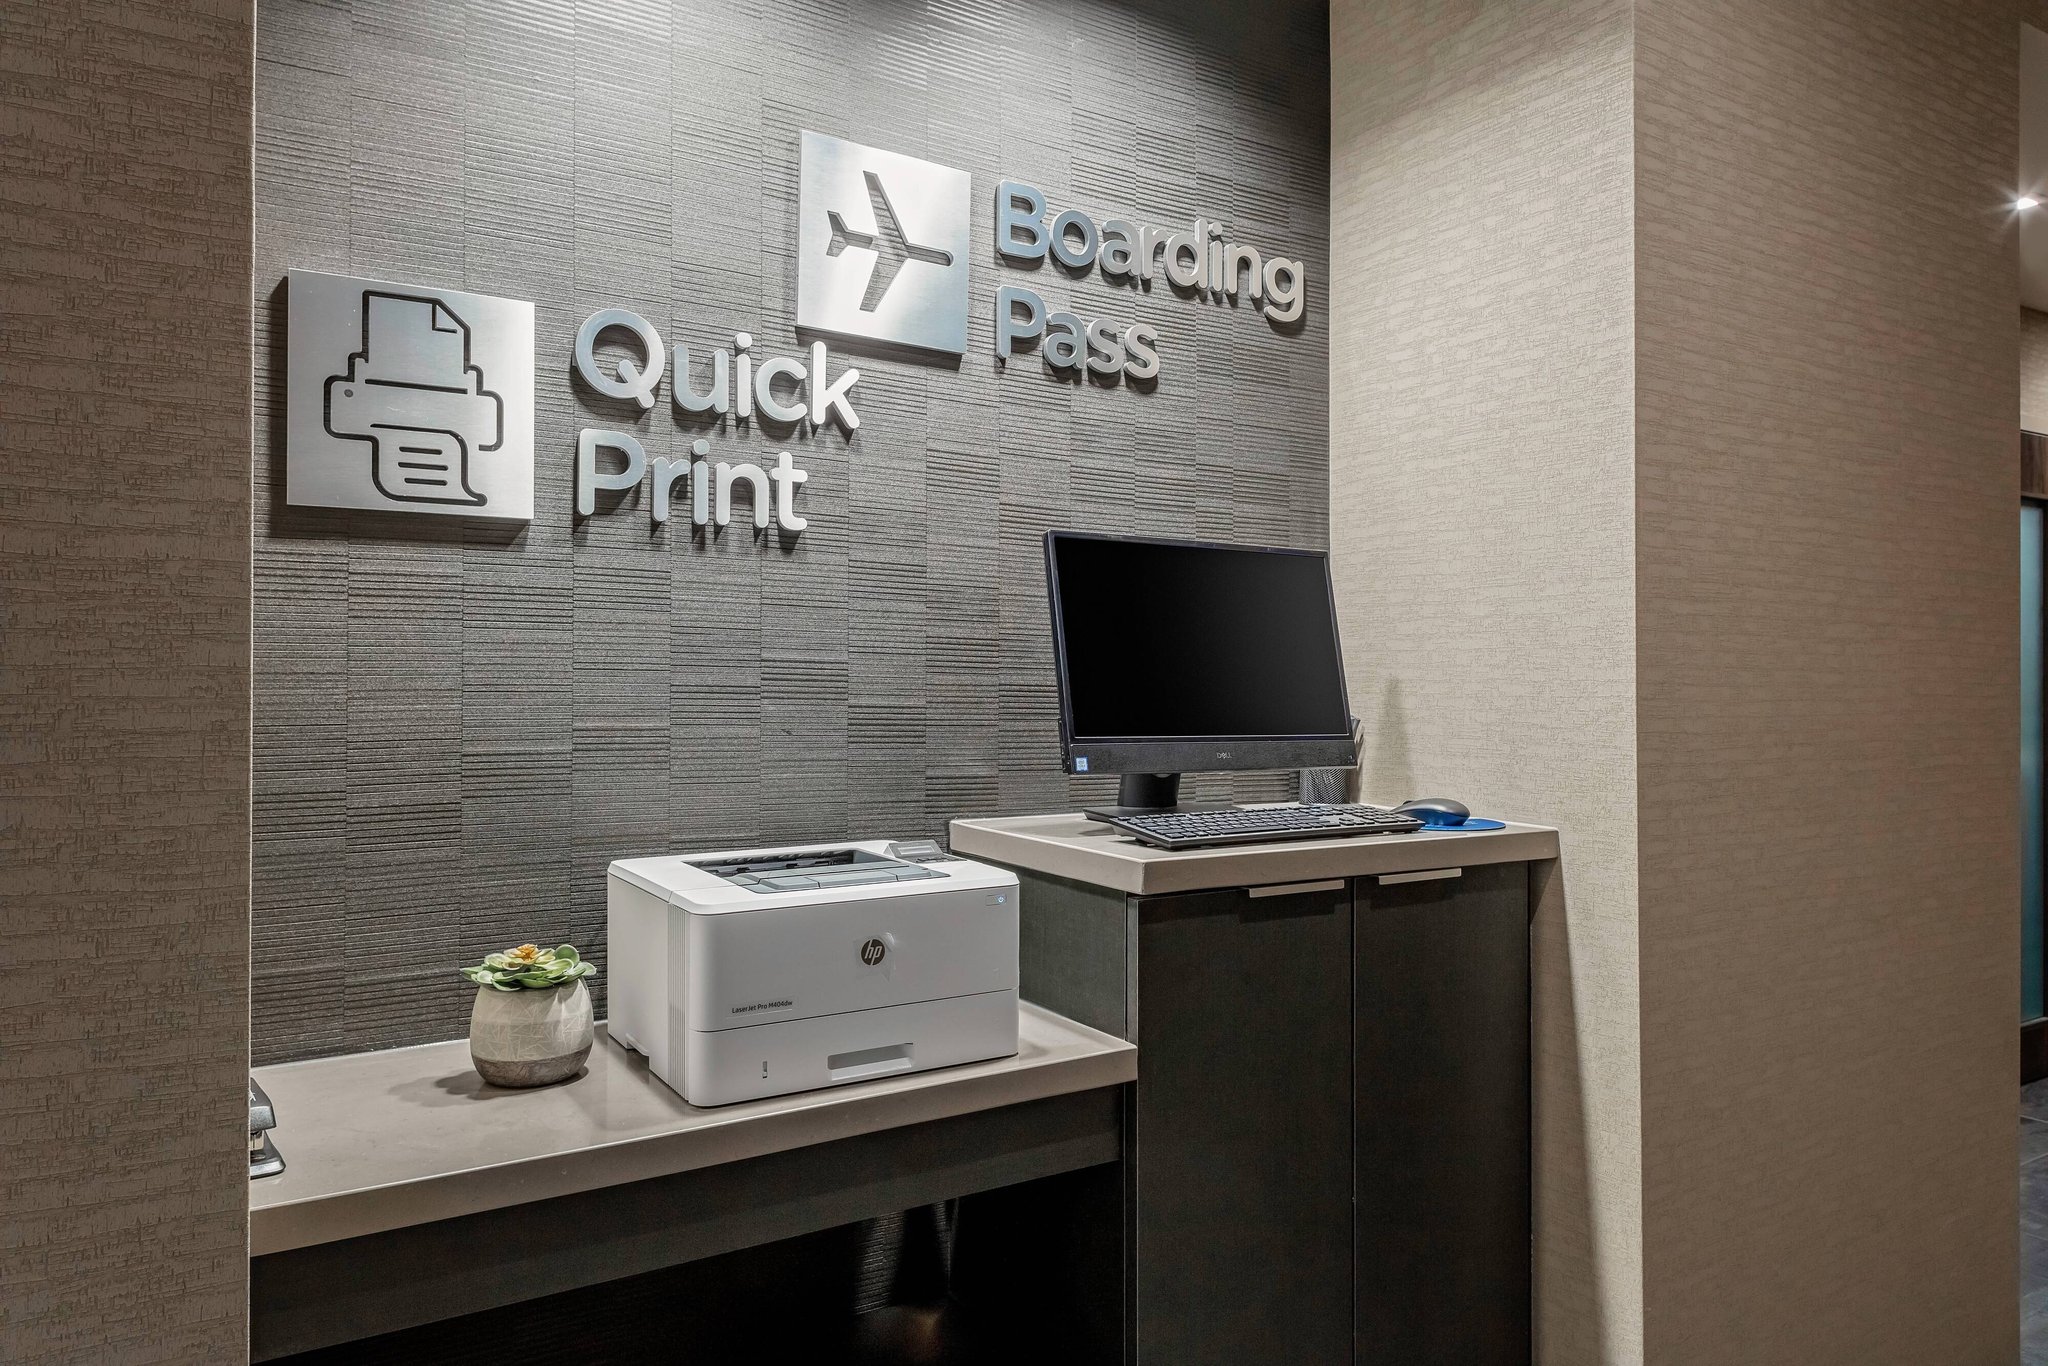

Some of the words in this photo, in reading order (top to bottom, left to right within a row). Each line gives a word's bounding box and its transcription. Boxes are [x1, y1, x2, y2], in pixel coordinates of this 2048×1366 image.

[996, 179, 1304, 322] Boarding
[575, 308, 860, 429] Quick
[996, 284, 1160, 379] Pass
[577, 428, 808, 531] Print
[863, 939, 884, 966] hp
[731, 1005, 756, 1014] LaserJet
[768, 1000, 793, 1008] M404dw
